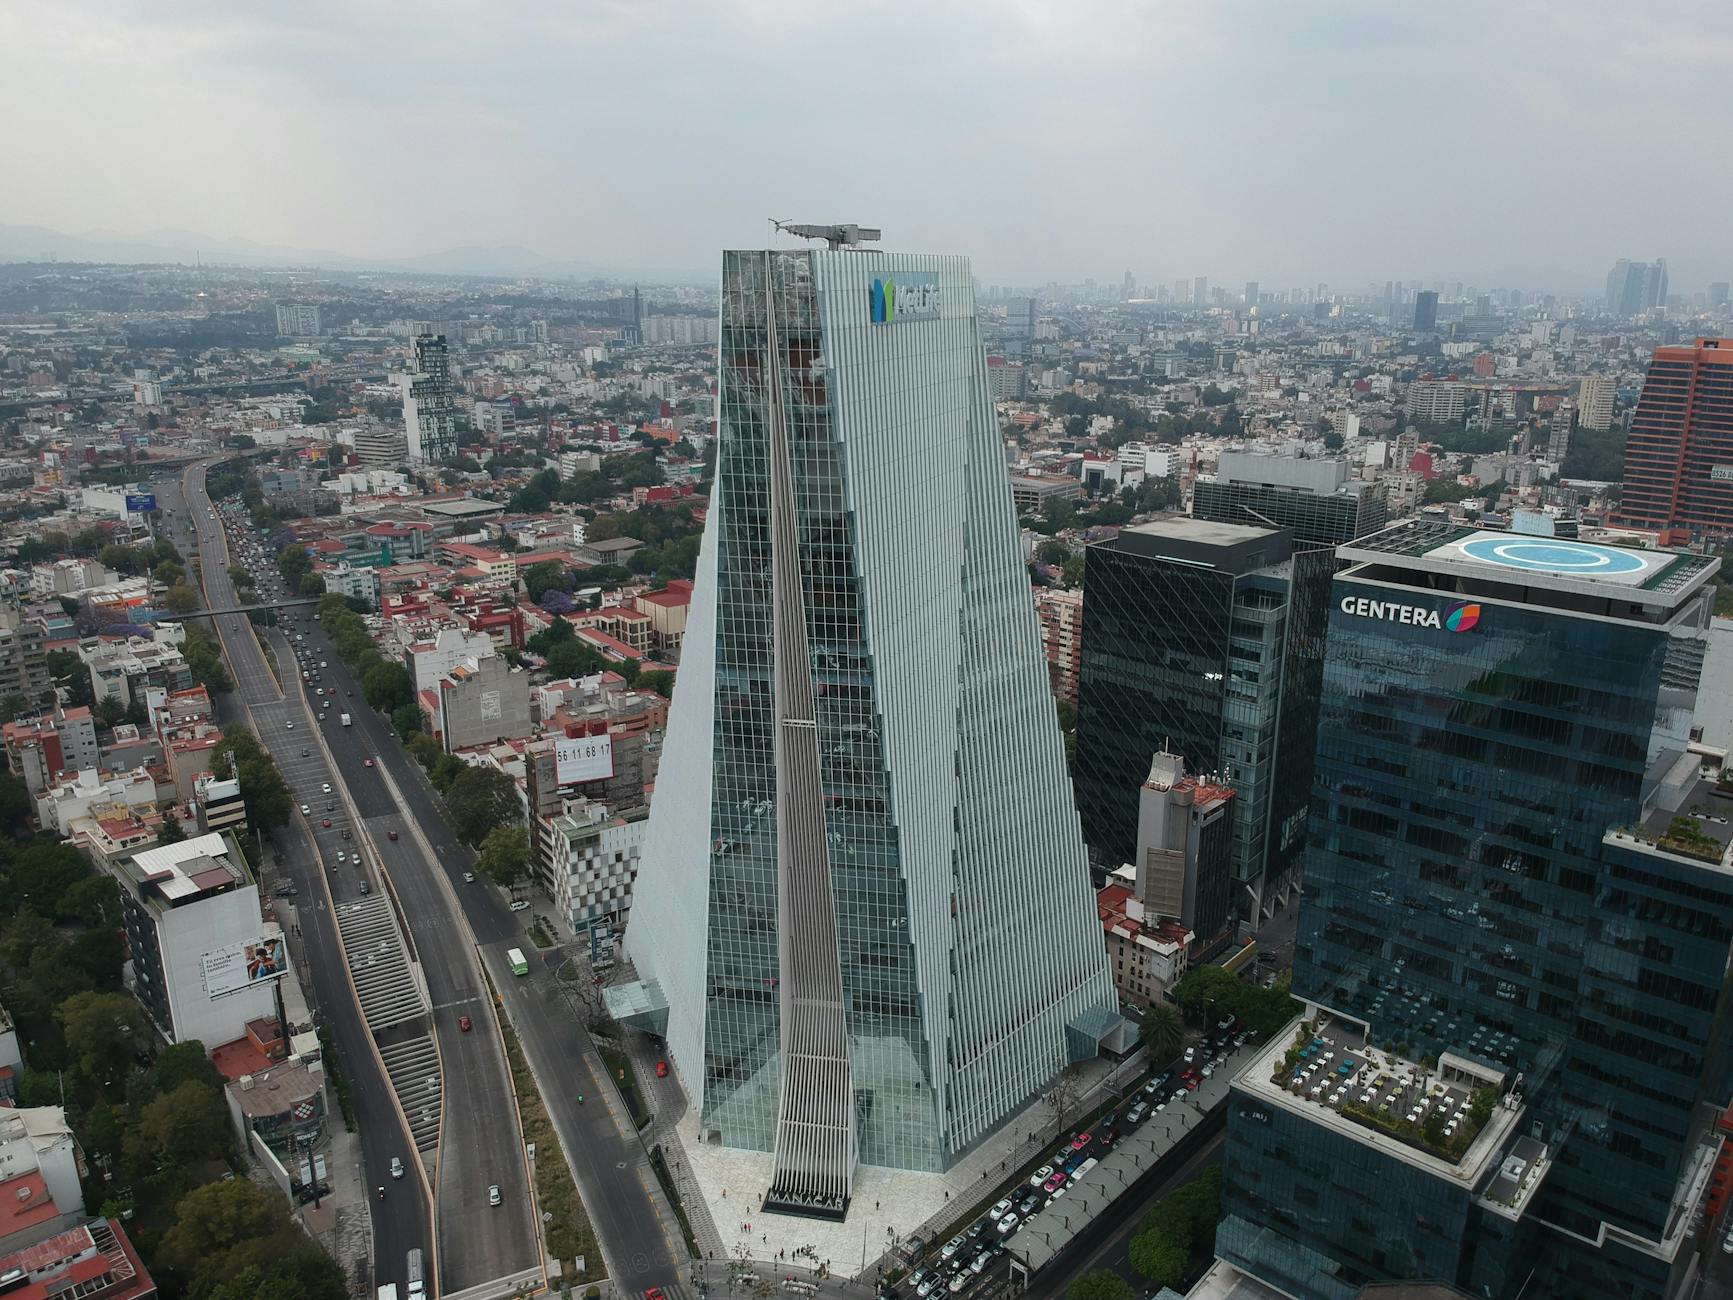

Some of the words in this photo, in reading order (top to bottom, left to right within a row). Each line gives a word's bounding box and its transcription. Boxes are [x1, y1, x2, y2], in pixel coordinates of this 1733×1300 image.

[1341, 597, 1441, 629] GENTERA
[557, 750, 568, 762] 56
[572, 748, 581, 760] 11
[586, 746, 596, 758] 68
[600, 743, 610, 755] 17
[768, 1191, 843, 1210] MANACAR
